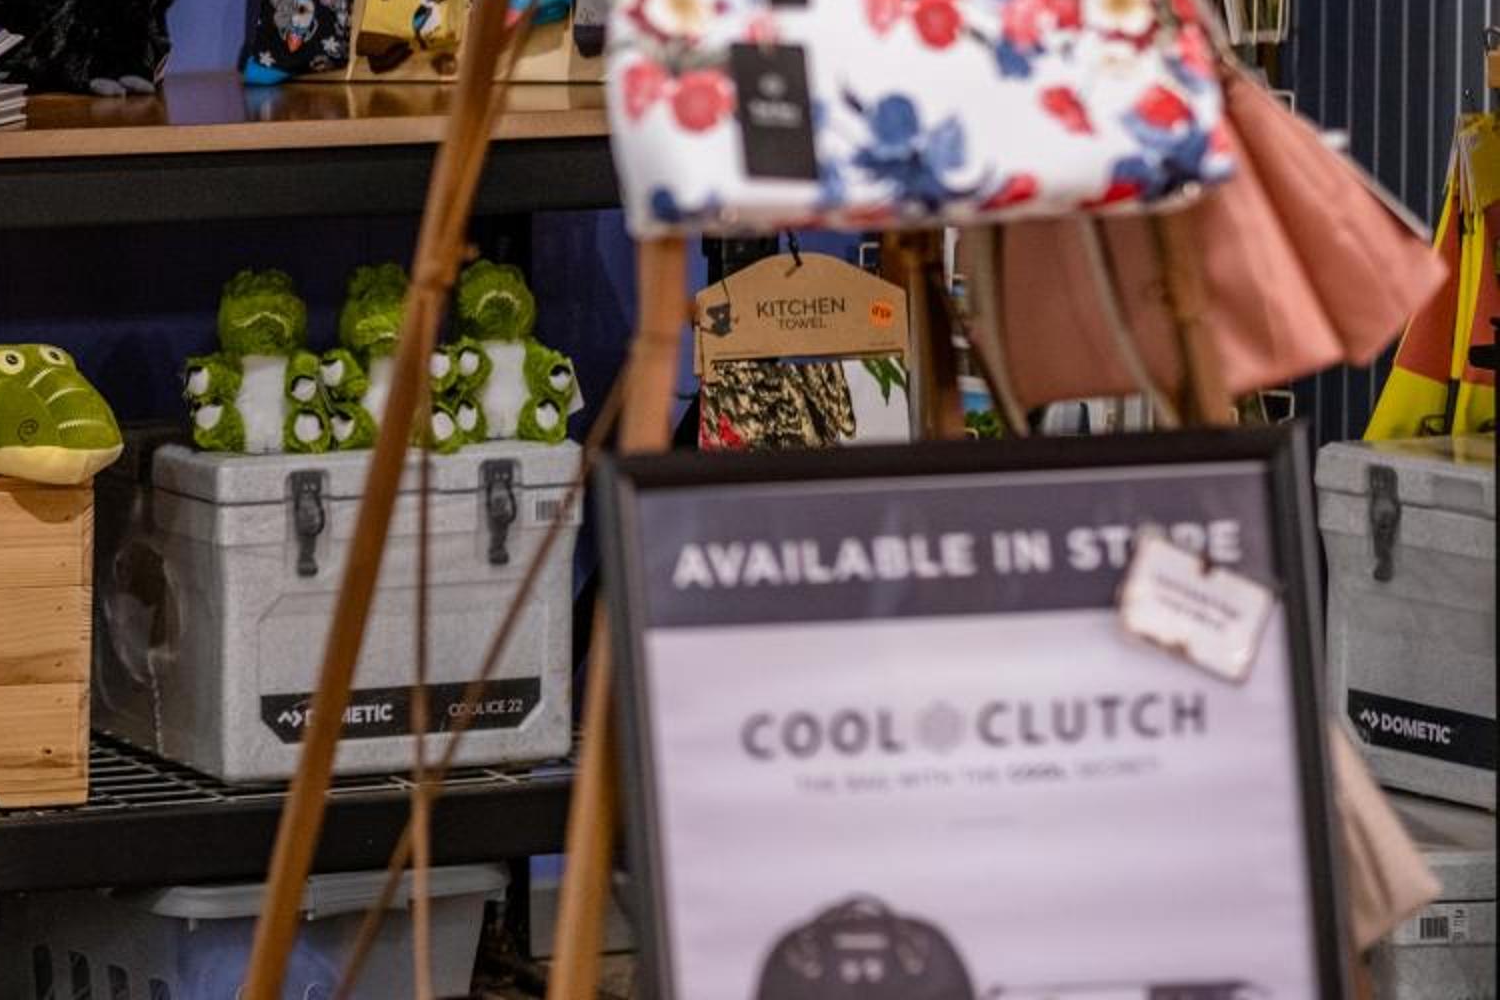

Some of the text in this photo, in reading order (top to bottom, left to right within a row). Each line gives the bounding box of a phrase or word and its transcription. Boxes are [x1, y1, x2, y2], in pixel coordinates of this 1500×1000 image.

[756, 297, 846, 319] KITCHEN
[778, 317, 827, 331] TOWEL
[673, 532, 976, 589] AVAILABLE
[992, 530, 1052, 572] IN
[739, 692, 1208, 762] COOL CLUTCH
[1380, 714, 1452, 746] DOMETIC
